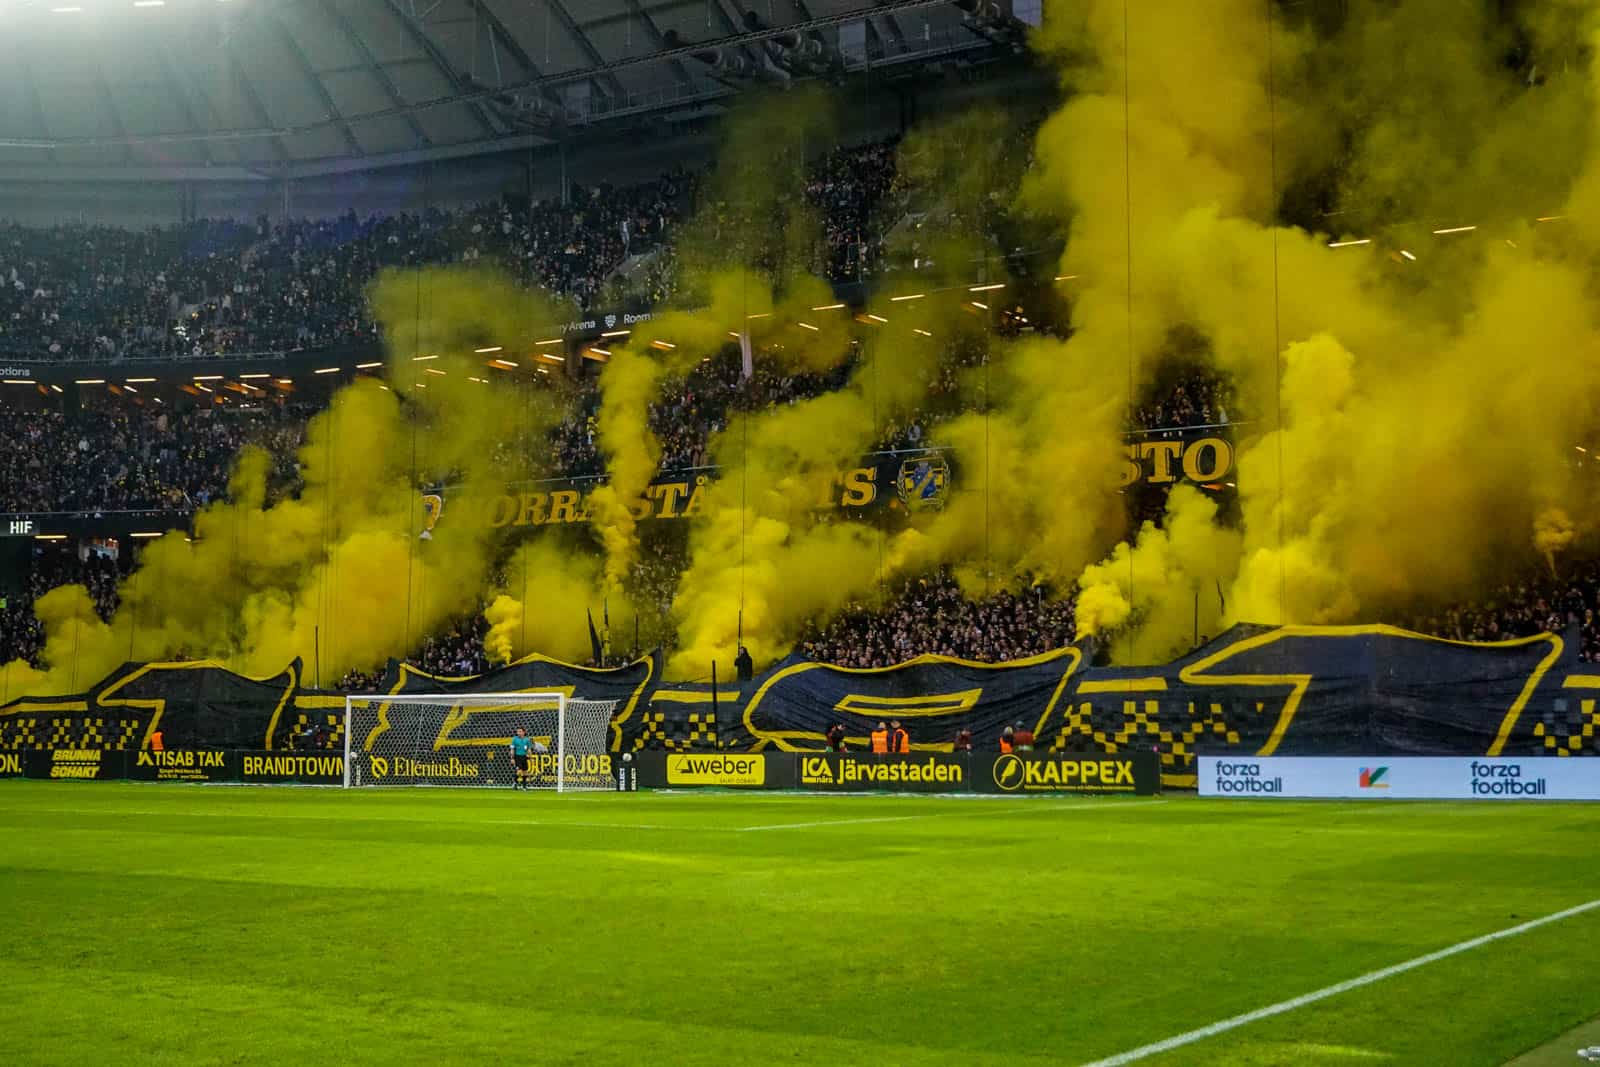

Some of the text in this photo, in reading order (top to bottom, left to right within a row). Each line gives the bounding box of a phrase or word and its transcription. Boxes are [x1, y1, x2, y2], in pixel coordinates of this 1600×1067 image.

[569, 320, 596, 332] Arena
[9, 521, 33, 535] HIF
[52, 749, 101, 761] BRUNNA
[154, 751, 225, 767] TISAB TAK
[50, 765, 100, 779] SCHAKT
[694, 755, 757, 775] weber
[802, 757, 833, 777] ICA
[837, 757, 962, 785] Järvastaden
[1025, 760, 1135, 784] KAPPEX
[1216, 759, 1260, 777] forza
[1471, 760, 1521, 777] forza
[1216, 776, 1282, 793] football
[1471, 778, 1546, 795] football
